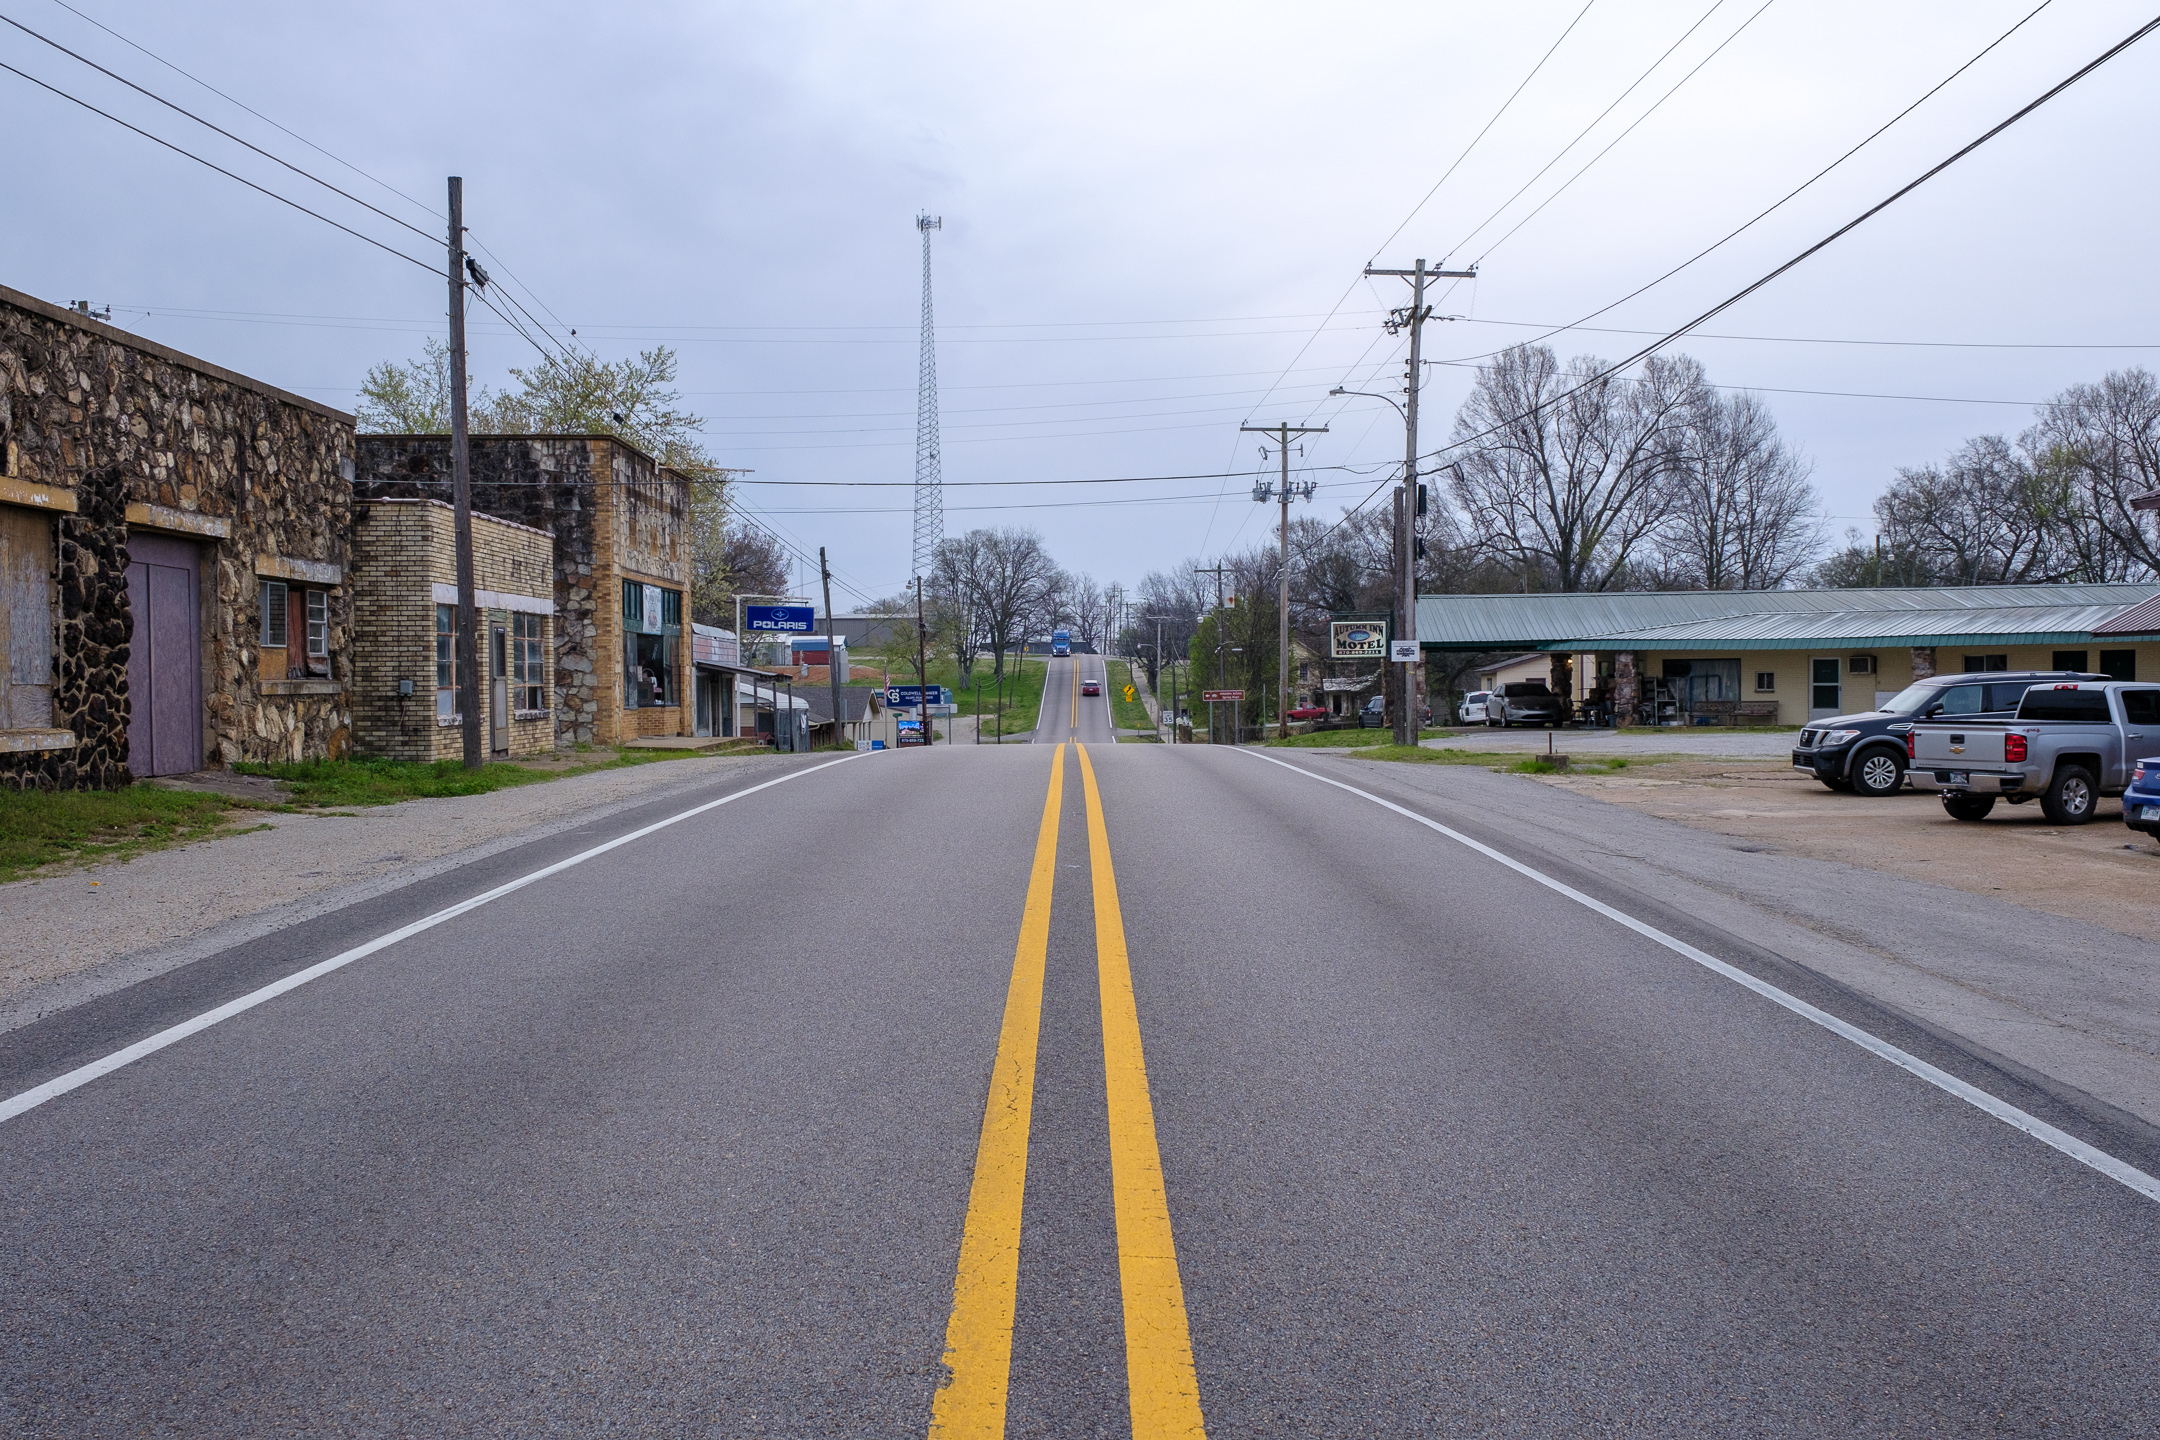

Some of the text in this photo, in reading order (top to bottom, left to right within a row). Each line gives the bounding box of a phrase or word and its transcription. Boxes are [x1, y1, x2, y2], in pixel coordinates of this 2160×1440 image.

[753, 620, 807, 630] POLARIS
[1334, 624, 1384, 639] AUTUMN INN
[1336, 638, 1384, 650] MOTEL
